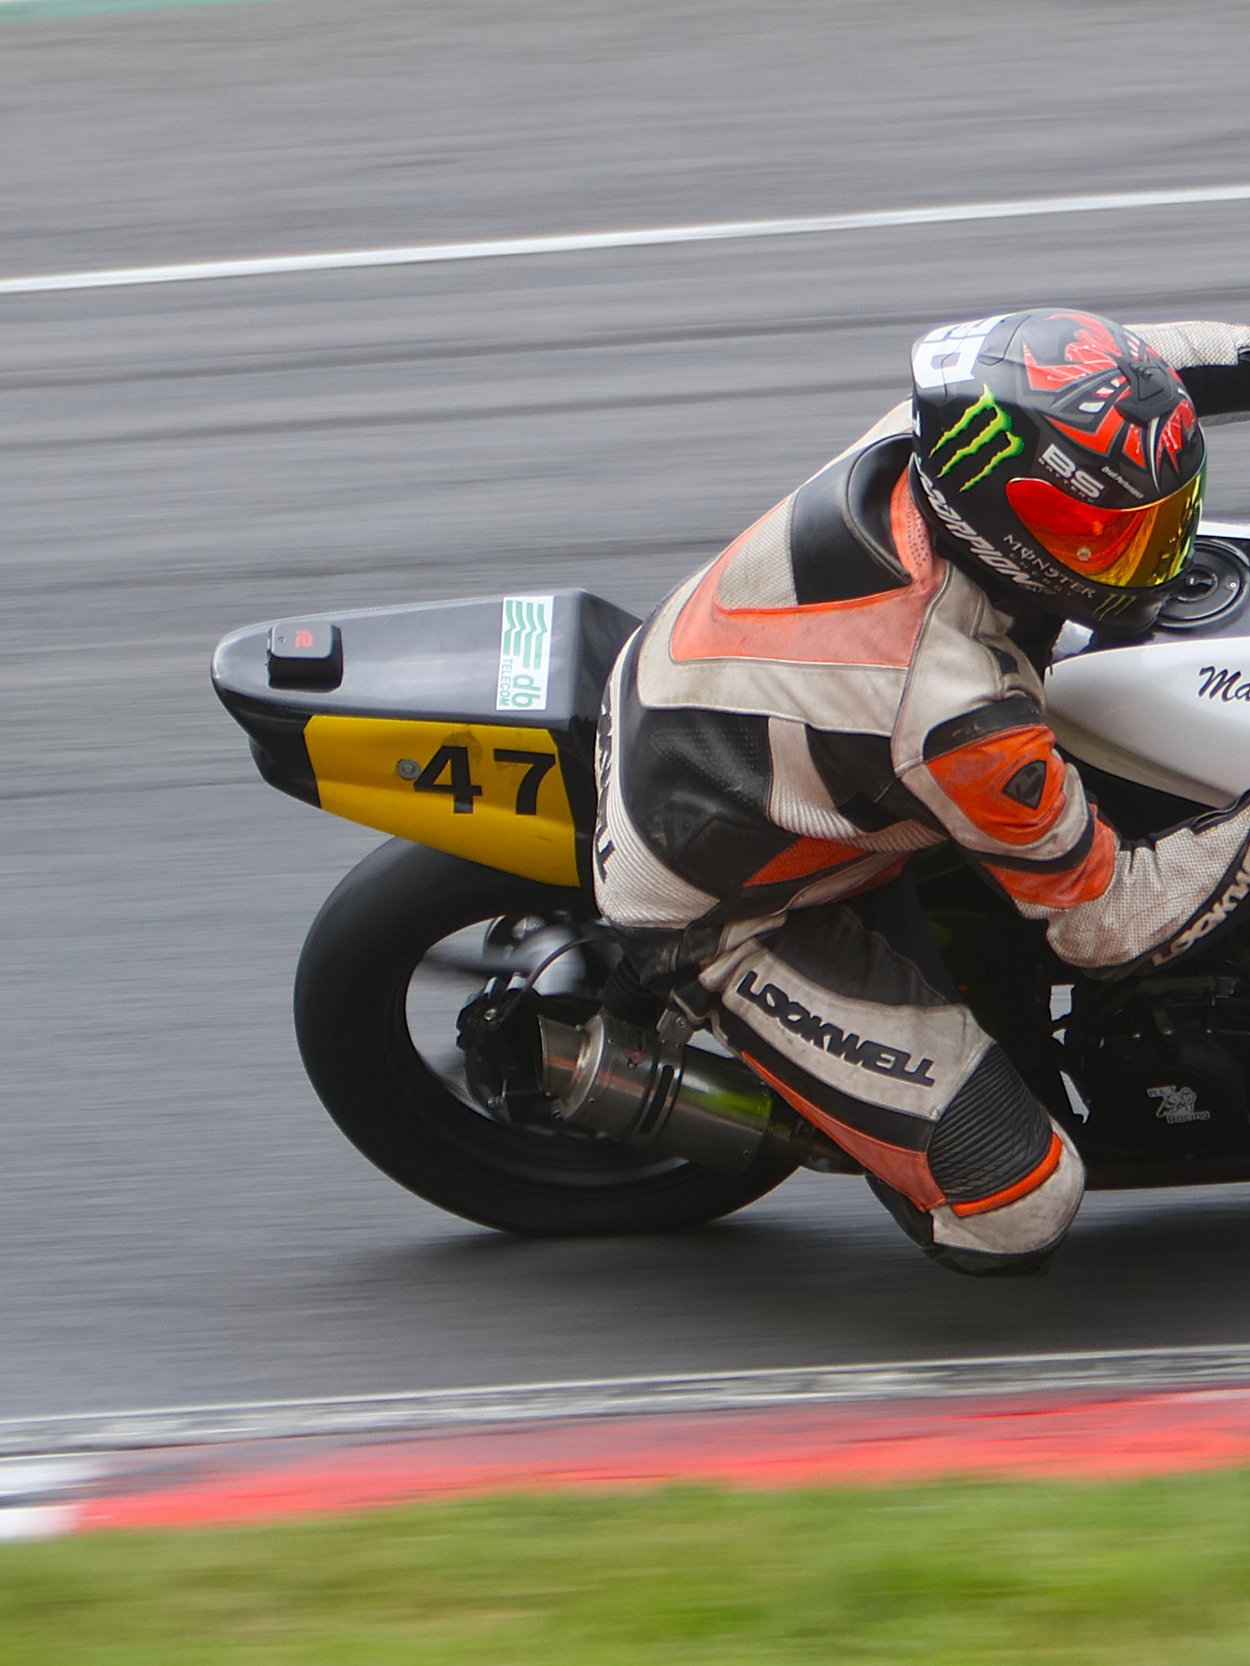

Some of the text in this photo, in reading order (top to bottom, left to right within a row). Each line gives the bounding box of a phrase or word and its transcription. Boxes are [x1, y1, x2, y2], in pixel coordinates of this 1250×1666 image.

[1042, 444, 1105, 499] BS
[499, 658, 514, 707] TELECOM
[512, 673, 543, 709] db
[413, 745, 557, 816] 47
[736, 970, 936, 1088] LOOKWELL
